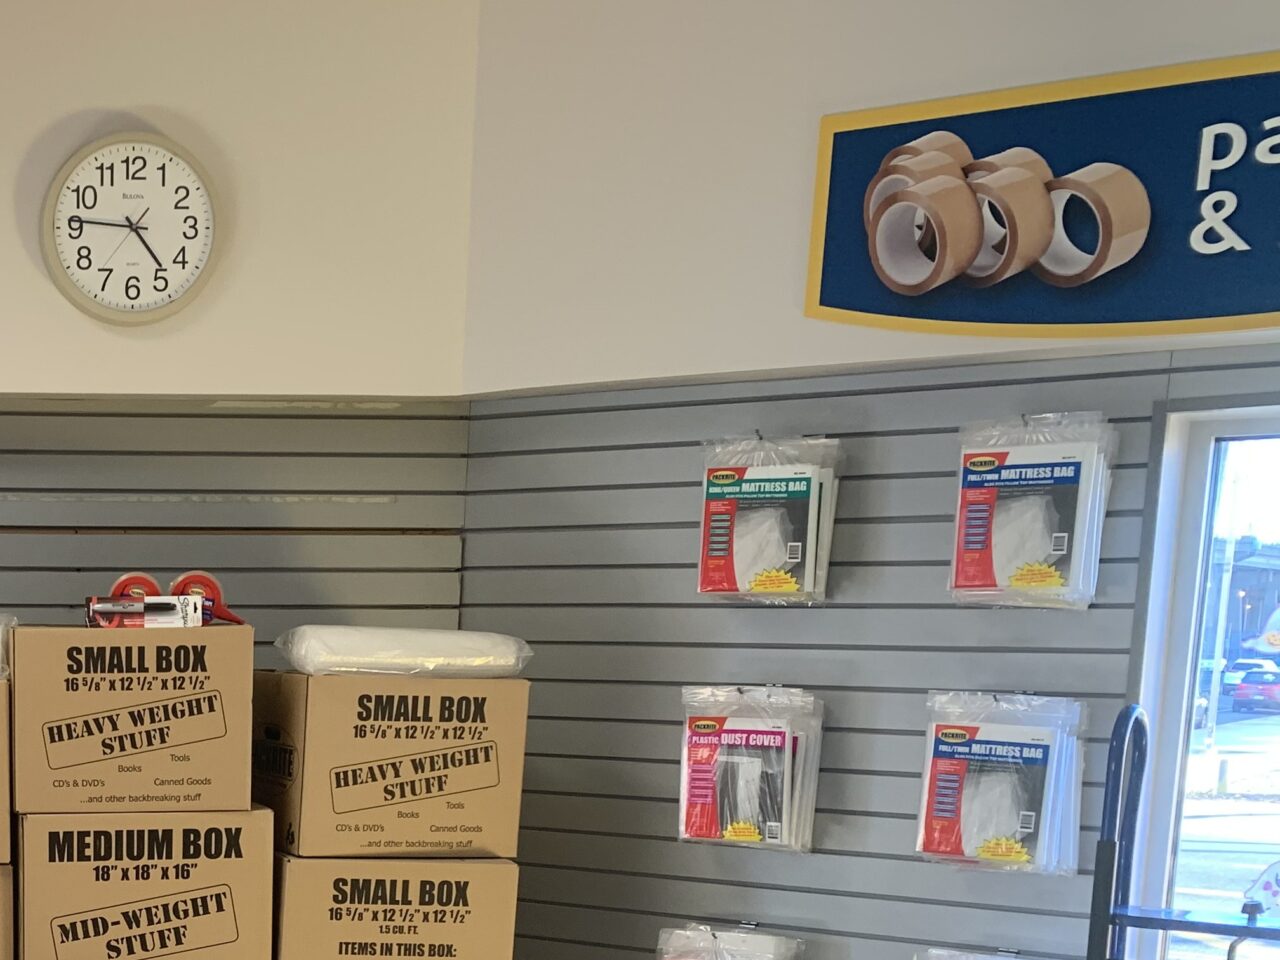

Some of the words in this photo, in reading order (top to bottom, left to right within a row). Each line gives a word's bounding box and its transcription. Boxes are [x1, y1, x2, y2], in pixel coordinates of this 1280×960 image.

[96, 163, 114, 186] 11
[121, 156, 147, 180] 12
[157, 163, 165, 187] 1
[71, 185, 97, 209] 10
[174, 186, 190, 209] 2
[68, 215, 83, 239] 9
[183, 216, 198, 240] 3
[1189, 190, 1251, 254] &
[77, 246, 92, 270] 8
[173, 246, 188, 270] 4
[98, 268, 113, 291] 7
[125, 276, 140, 300] 6
[153, 268, 168, 292] 5
[1000, 467, 1052, 480] MATTRESS
[1053, 466, 1074, 477] BAG
[741, 482, 786, 492] MATTRESS
[788, 481, 807, 491] BAG
[67, 646, 149, 674] SMALL
[156, 645, 207, 673] BOX
[47, 714, 120, 744] HEAVY
[128, 695, 217, 727] WEIGHT
[357, 694, 433, 722] SMALL
[439, 696, 488, 724] BOX
[101, 726, 170, 756] STUFF
[692, 736, 719, 744] PLASTIC
[721, 733, 747, 745] DUST
[749, 734, 781, 746] COVER
[971, 743, 1021, 758] MATTRESS
[1022, 747, 1043, 758] BAG
[118, 765, 142, 773] Books
[170, 754, 190, 762] Tools
[334, 761, 404, 789] HEAVY
[410, 745, 494, 775] WEIGHT
[154, 778, 184, 786] Canned
[187, 777, 211, 786] Goods
[383, 775, 449, 801] STUFF
[48, 829, 173, 863] MEDIUM
[182, 827, 243, 859] BOX
[332, 877, 412, 906] SMALL
[419, 879, 469, 907] BOX
[57, 892, 227, 944] MID-WEIGHT
[105, 926, 187, 960] STUFF
